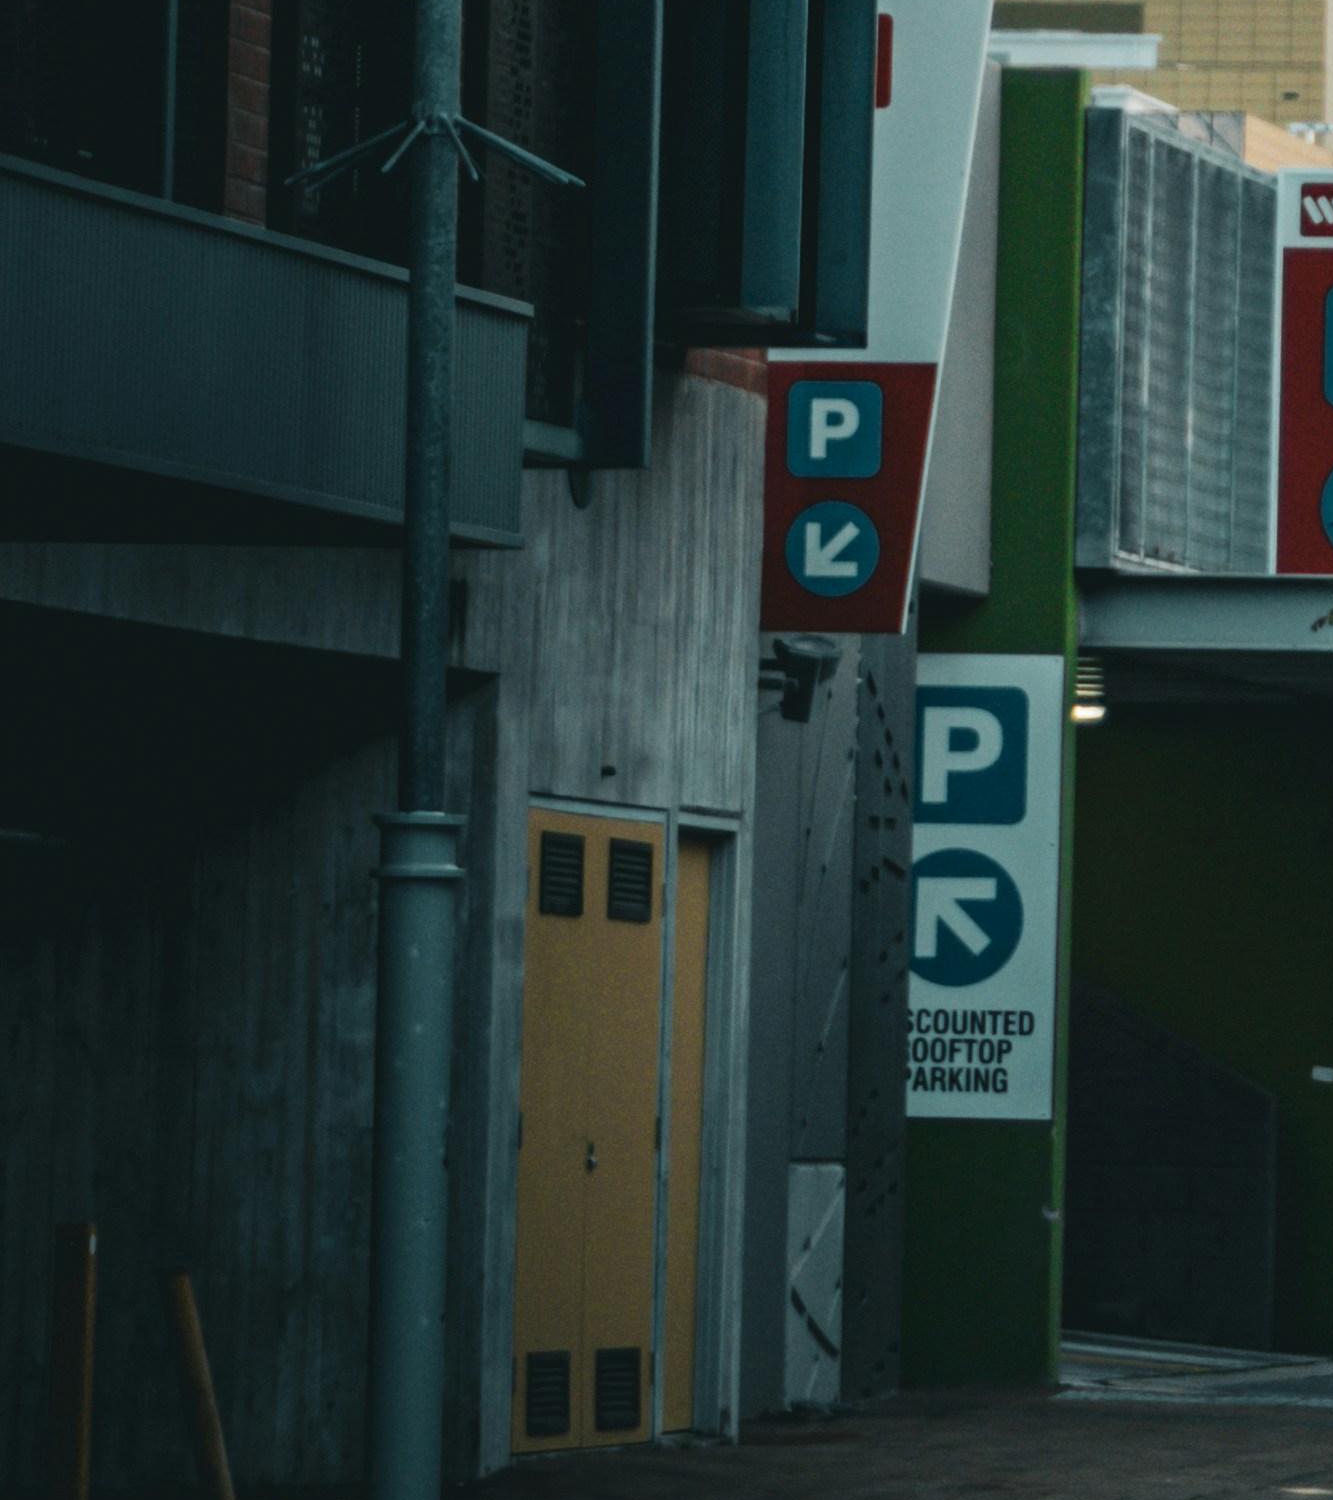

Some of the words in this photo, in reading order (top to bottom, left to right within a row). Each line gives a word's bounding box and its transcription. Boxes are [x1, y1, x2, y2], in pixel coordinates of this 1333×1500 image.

[809, 397, 859, 460] P
[920, 705, 1004, 804] P
[907, 1037, 1012, 1064] OOFTOP
